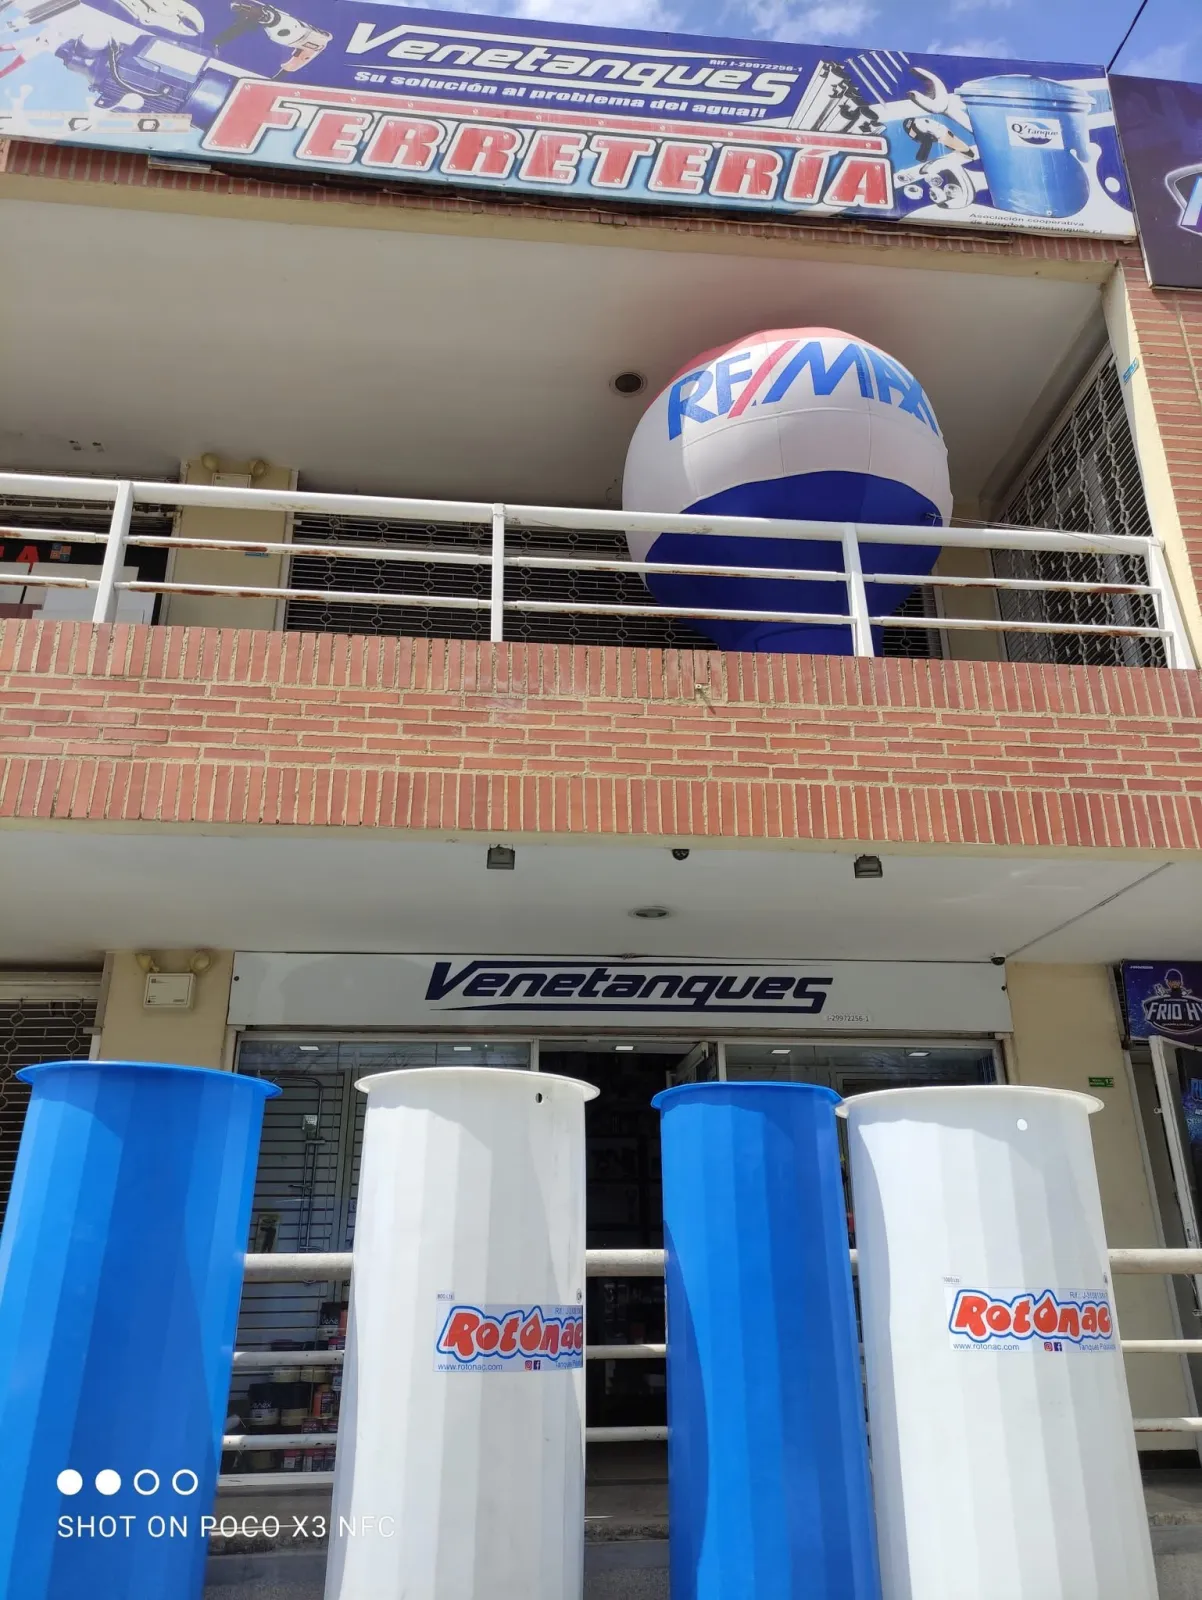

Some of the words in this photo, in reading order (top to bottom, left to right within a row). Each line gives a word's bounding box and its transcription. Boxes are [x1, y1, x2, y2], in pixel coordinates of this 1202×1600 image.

[345, 22, 799, 105] Venetanques
[354, 71, 387, 84] Su
[390, 77, 498, 95] solución
[502, 86, 526, 98] al
[529, 89, 645, 109] problema
[649, 98, 689, 112] del
[692, 103, 768, 118] agua!!
[201, 79, 894, 209] FERRETERÍA
[424, 960, 834, 1014] Venetanques
[1147, 1002, 1183, 1020] FRIO
[437, 1363, 503, 1371] www.rotonac.com
[953, 1343, 1020, 1351] www.rotonac.com
